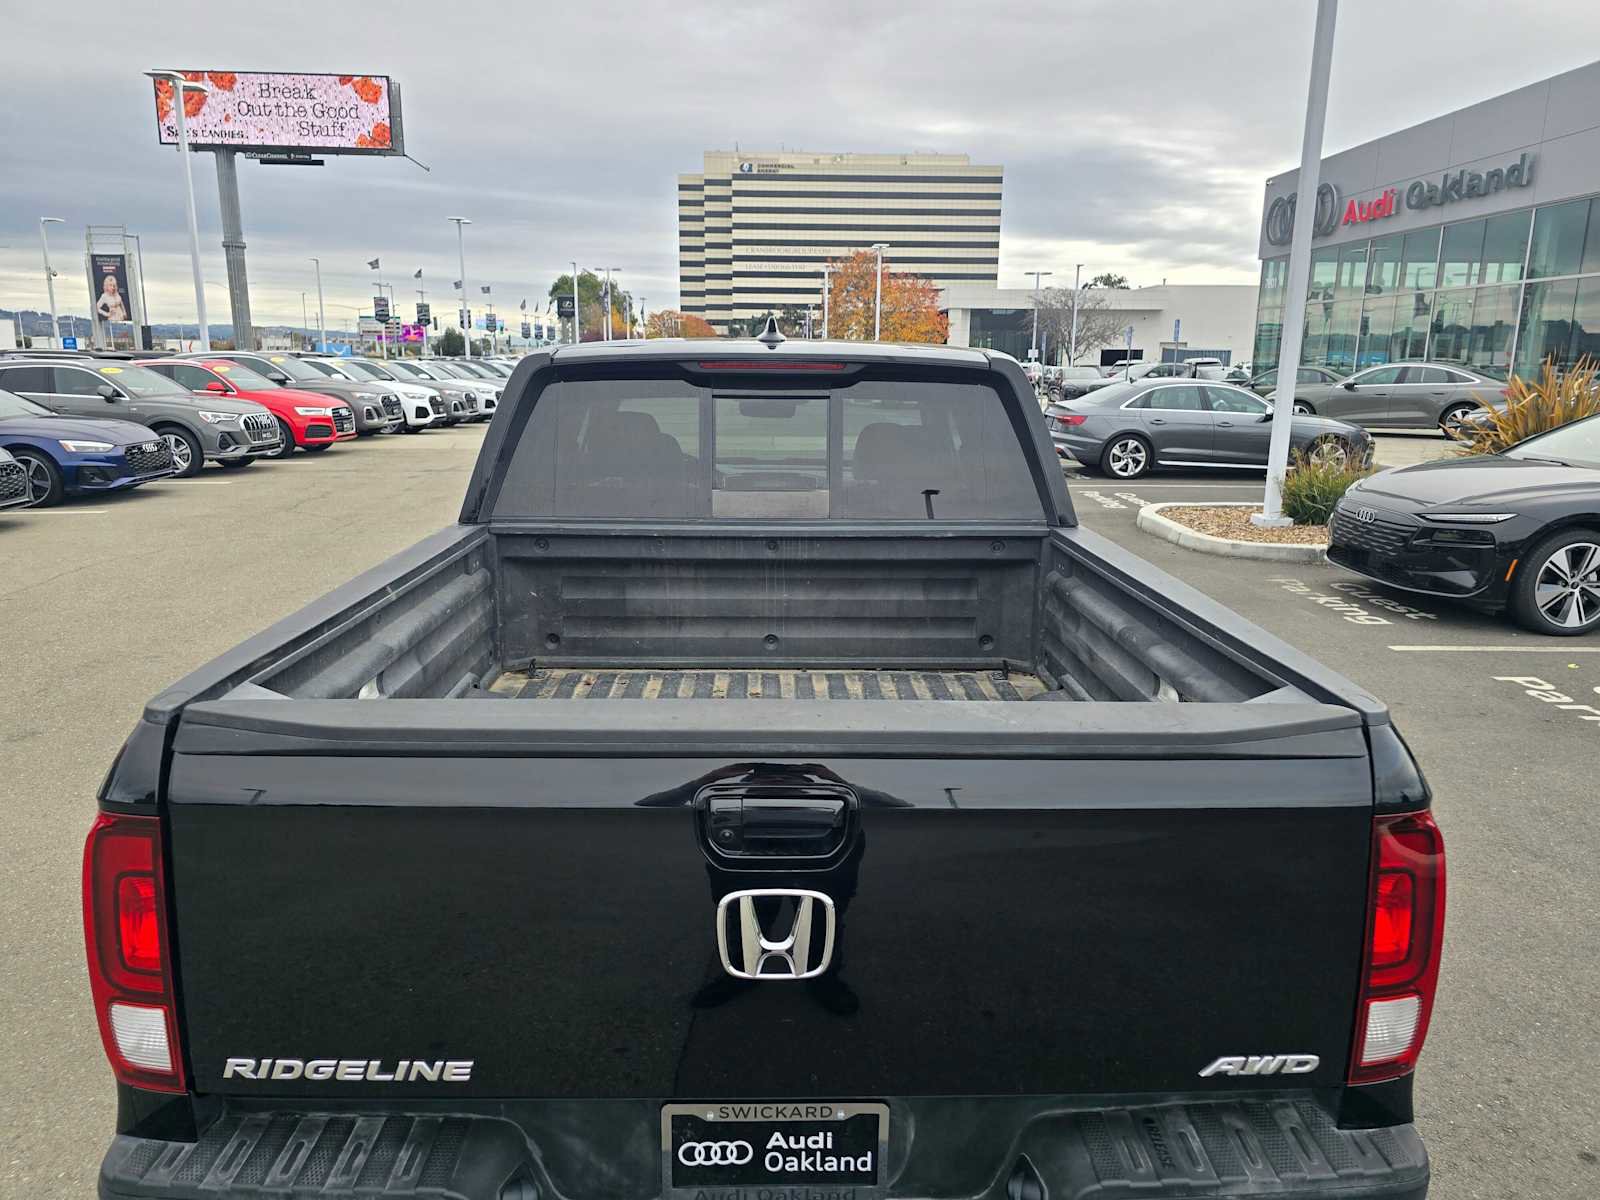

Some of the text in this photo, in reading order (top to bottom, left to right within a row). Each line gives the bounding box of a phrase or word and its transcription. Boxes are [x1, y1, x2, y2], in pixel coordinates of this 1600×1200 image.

[257, 83, 317, 100] Break
[237, 101, 360, 120] Out the Good
[299, 120, 346, 138] Stuff
[1342, 153, 1533, 225] Audi Oakland
[1264, 577, 1394, 625] Parking
[1329, 582, 1438, 620] Guest
[222, 1057, 475, 1082] RIDGELINE
[1198, 1053, 1320, 1077] AWD
[718, 1105, 833, 1119] SWICKARD
[765, 1131, 833, 1149] Audi
[764, 1151, 872, 1172] Oakland
